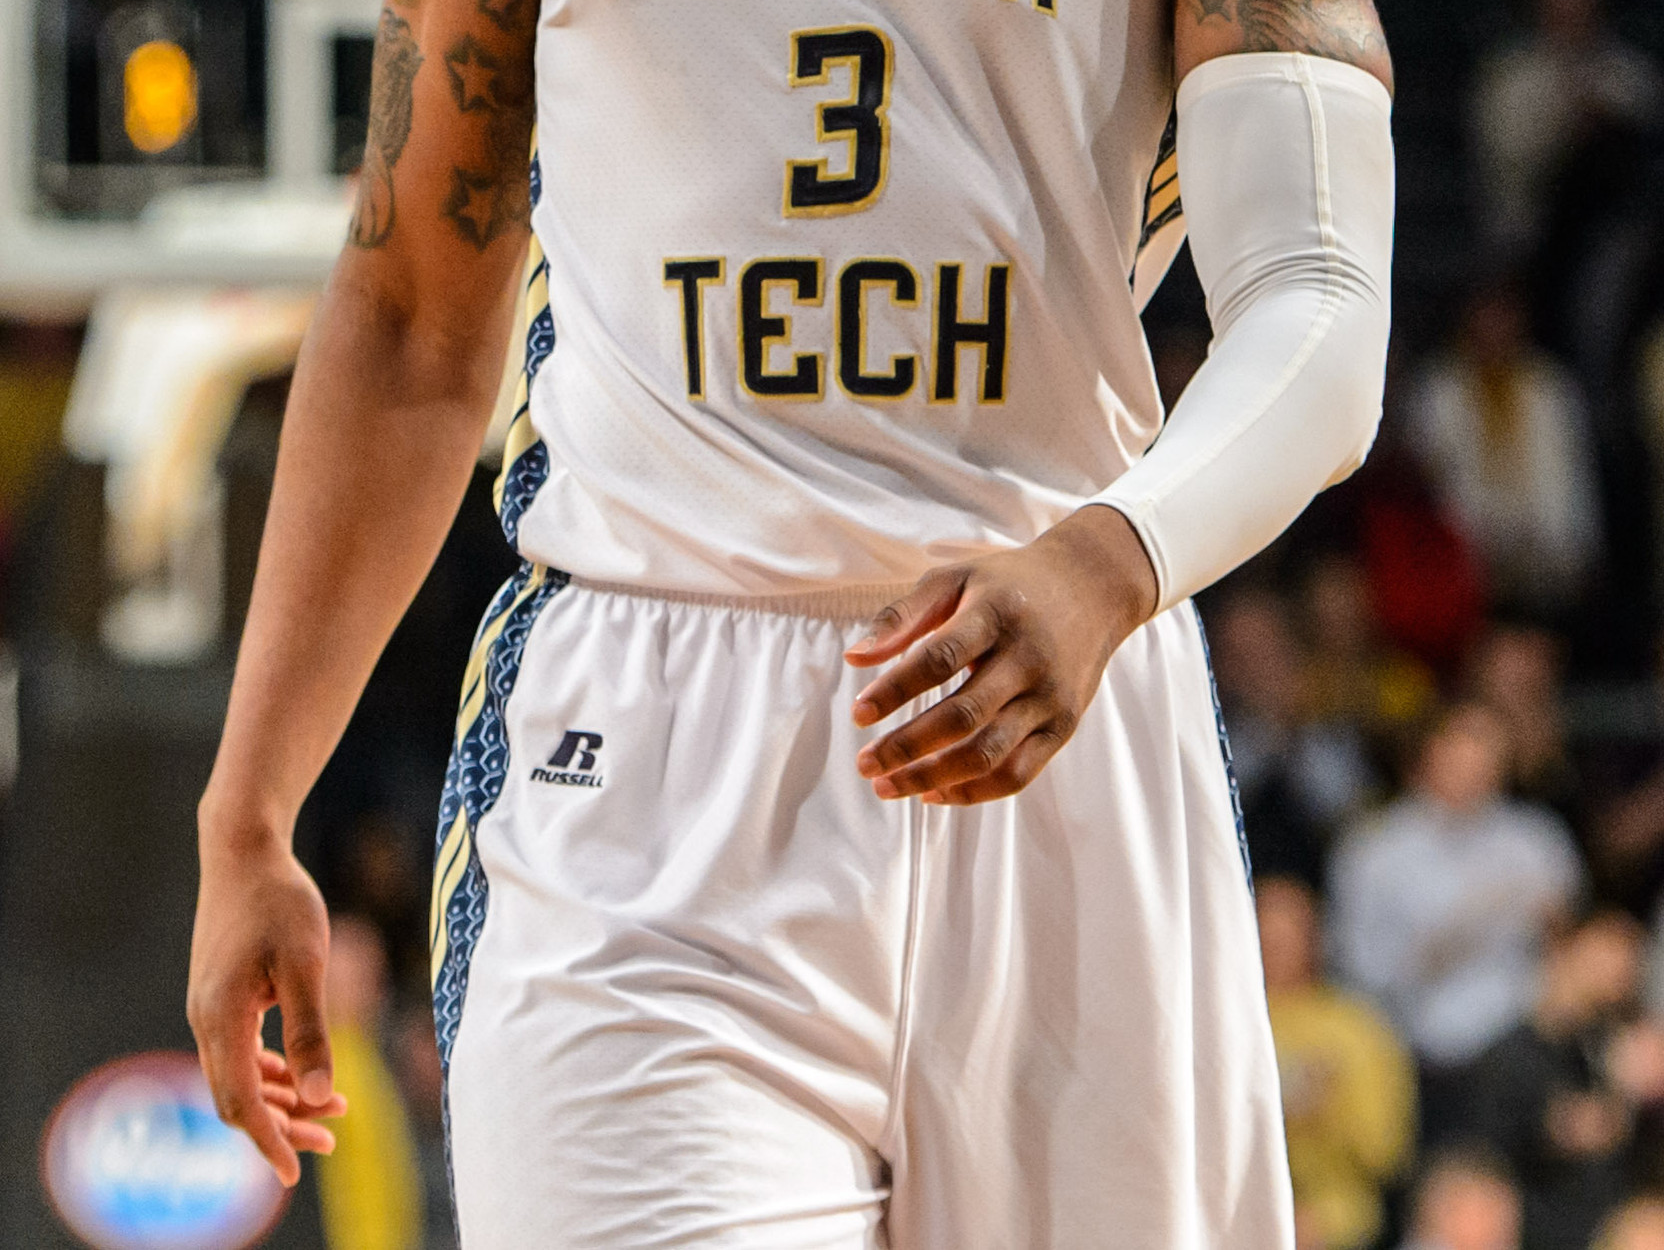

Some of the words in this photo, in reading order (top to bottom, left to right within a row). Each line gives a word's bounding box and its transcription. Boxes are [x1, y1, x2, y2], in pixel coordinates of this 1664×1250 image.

[782, 23, 896, 219] 3
[662, 255, 1014, 406] TECH
[529, 768, 604, 788] RUSSELL
